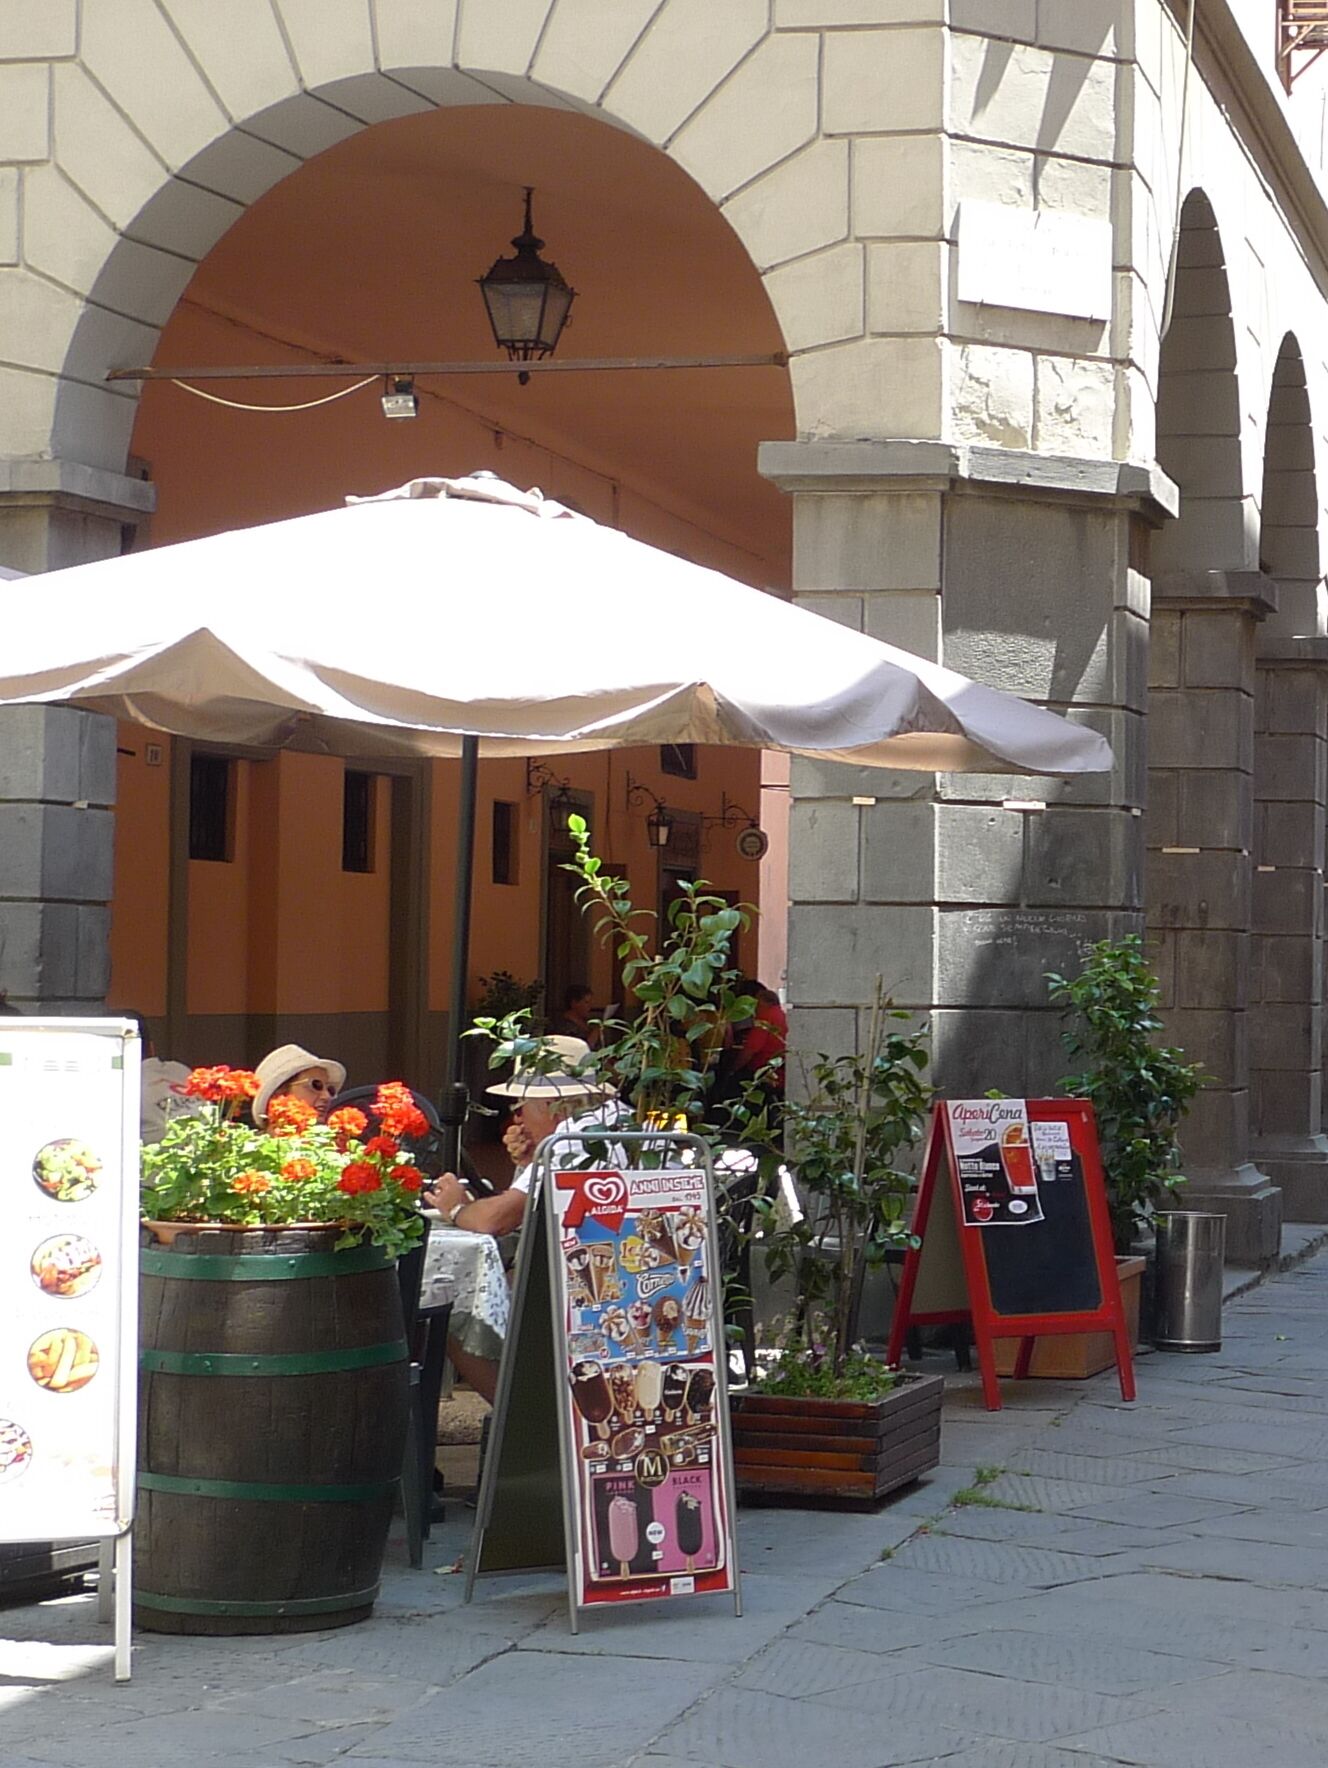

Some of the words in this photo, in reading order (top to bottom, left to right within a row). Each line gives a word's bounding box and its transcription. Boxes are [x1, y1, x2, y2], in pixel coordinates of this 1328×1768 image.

[952, 1103, 1023, 1125] AperiCena
[984, 1128, 997, 1141] 20
[660, 1175, 705, 1193] INSIEME
[605, 1480, 636, 1492] PINK
[672, 1475, 702, 1486] BLACK
